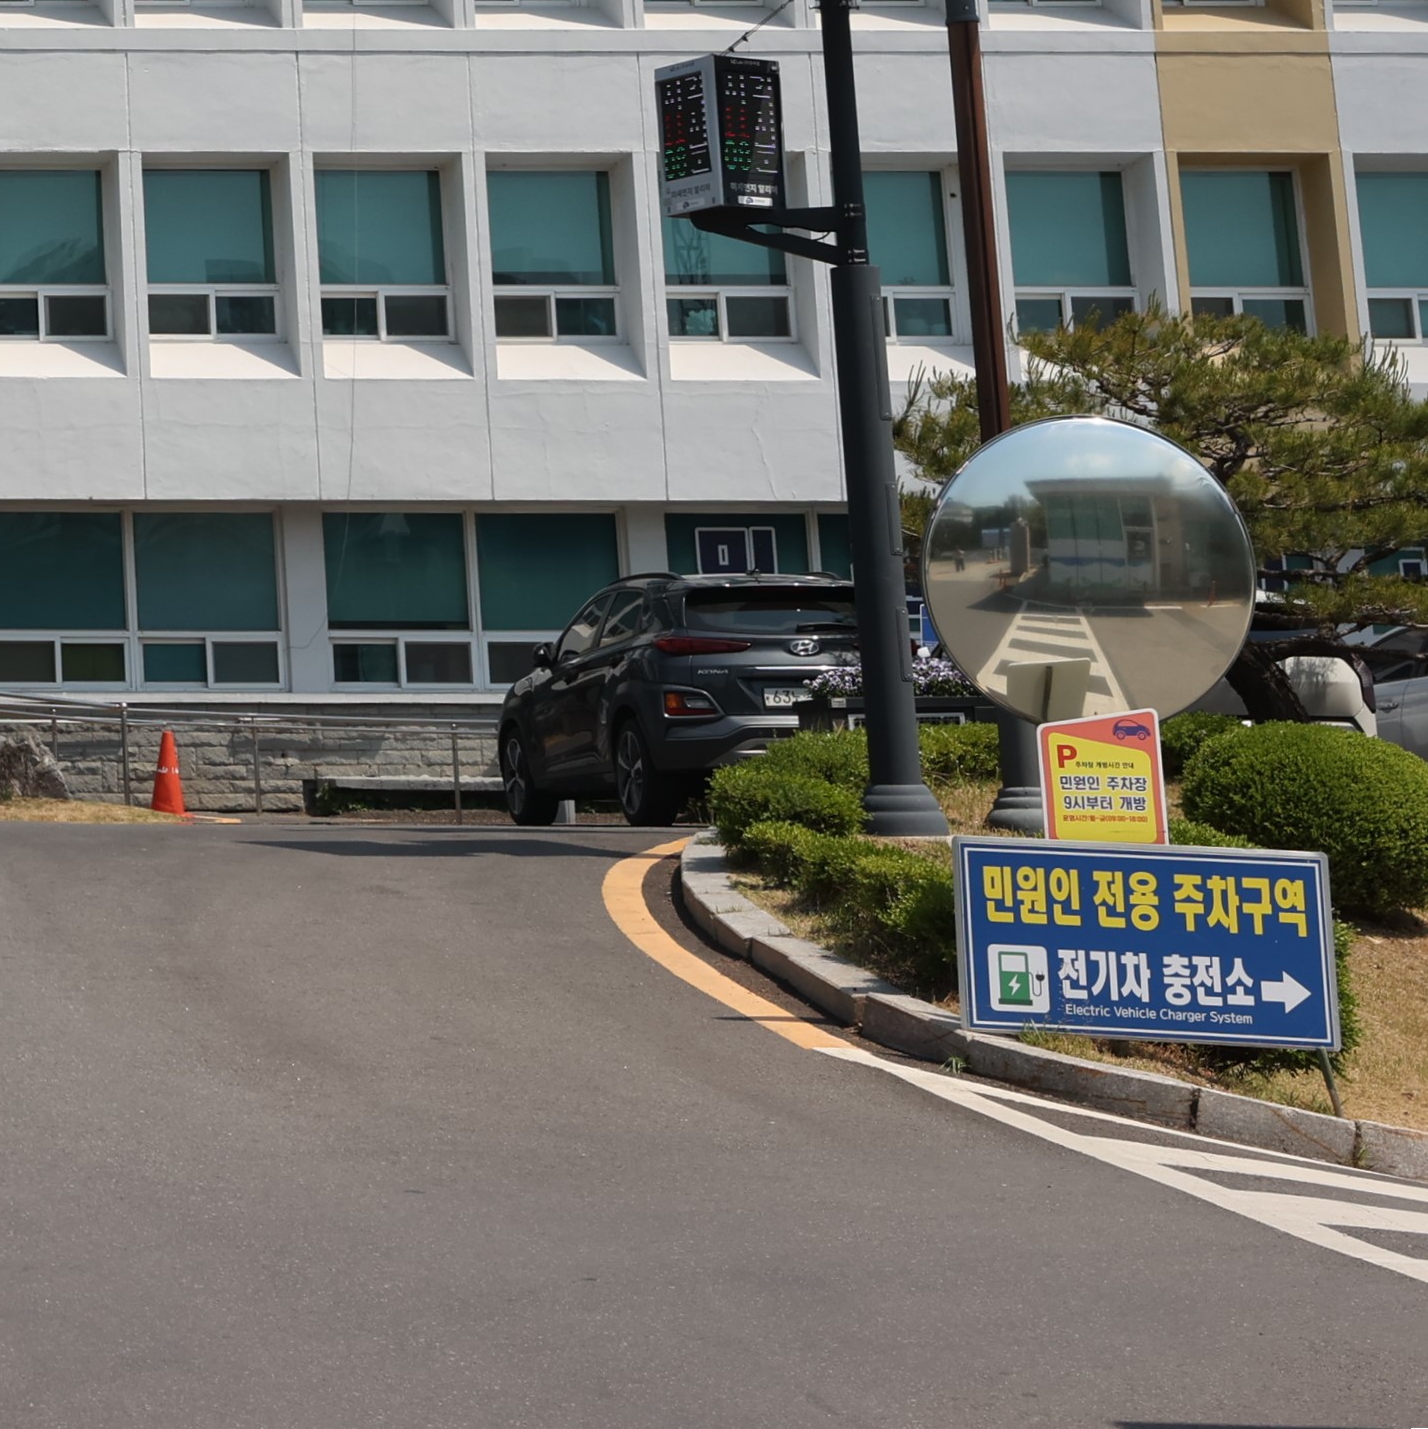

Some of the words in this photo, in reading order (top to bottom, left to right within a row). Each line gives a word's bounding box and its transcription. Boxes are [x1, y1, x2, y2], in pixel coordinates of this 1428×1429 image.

[1057, 744, 1077, 768] P
[1060, 776, 1100, 791] 민원인
[1106, 776, 1147, 792] 주차장
[1063, 795, 1113, 810] 9시부터
[1119, 796, 1146, 811] 개방
[983, 865, 1082, 926] 민원인
[1093, 871, 1160, 931] 전용
[1173, 874, 1308, 938] 주차구역
[1057, 949, 1151, 1003] 전기차
[1162, 954, 1255, 1007] 충전소
[1065, 1003, 1111, 1017] Electric
[1114, 1006, 1157, 1020] Vehicle
[1160, 1008, 1206, 1023] Charger
[1209, 1011, 1253, 1025] System
